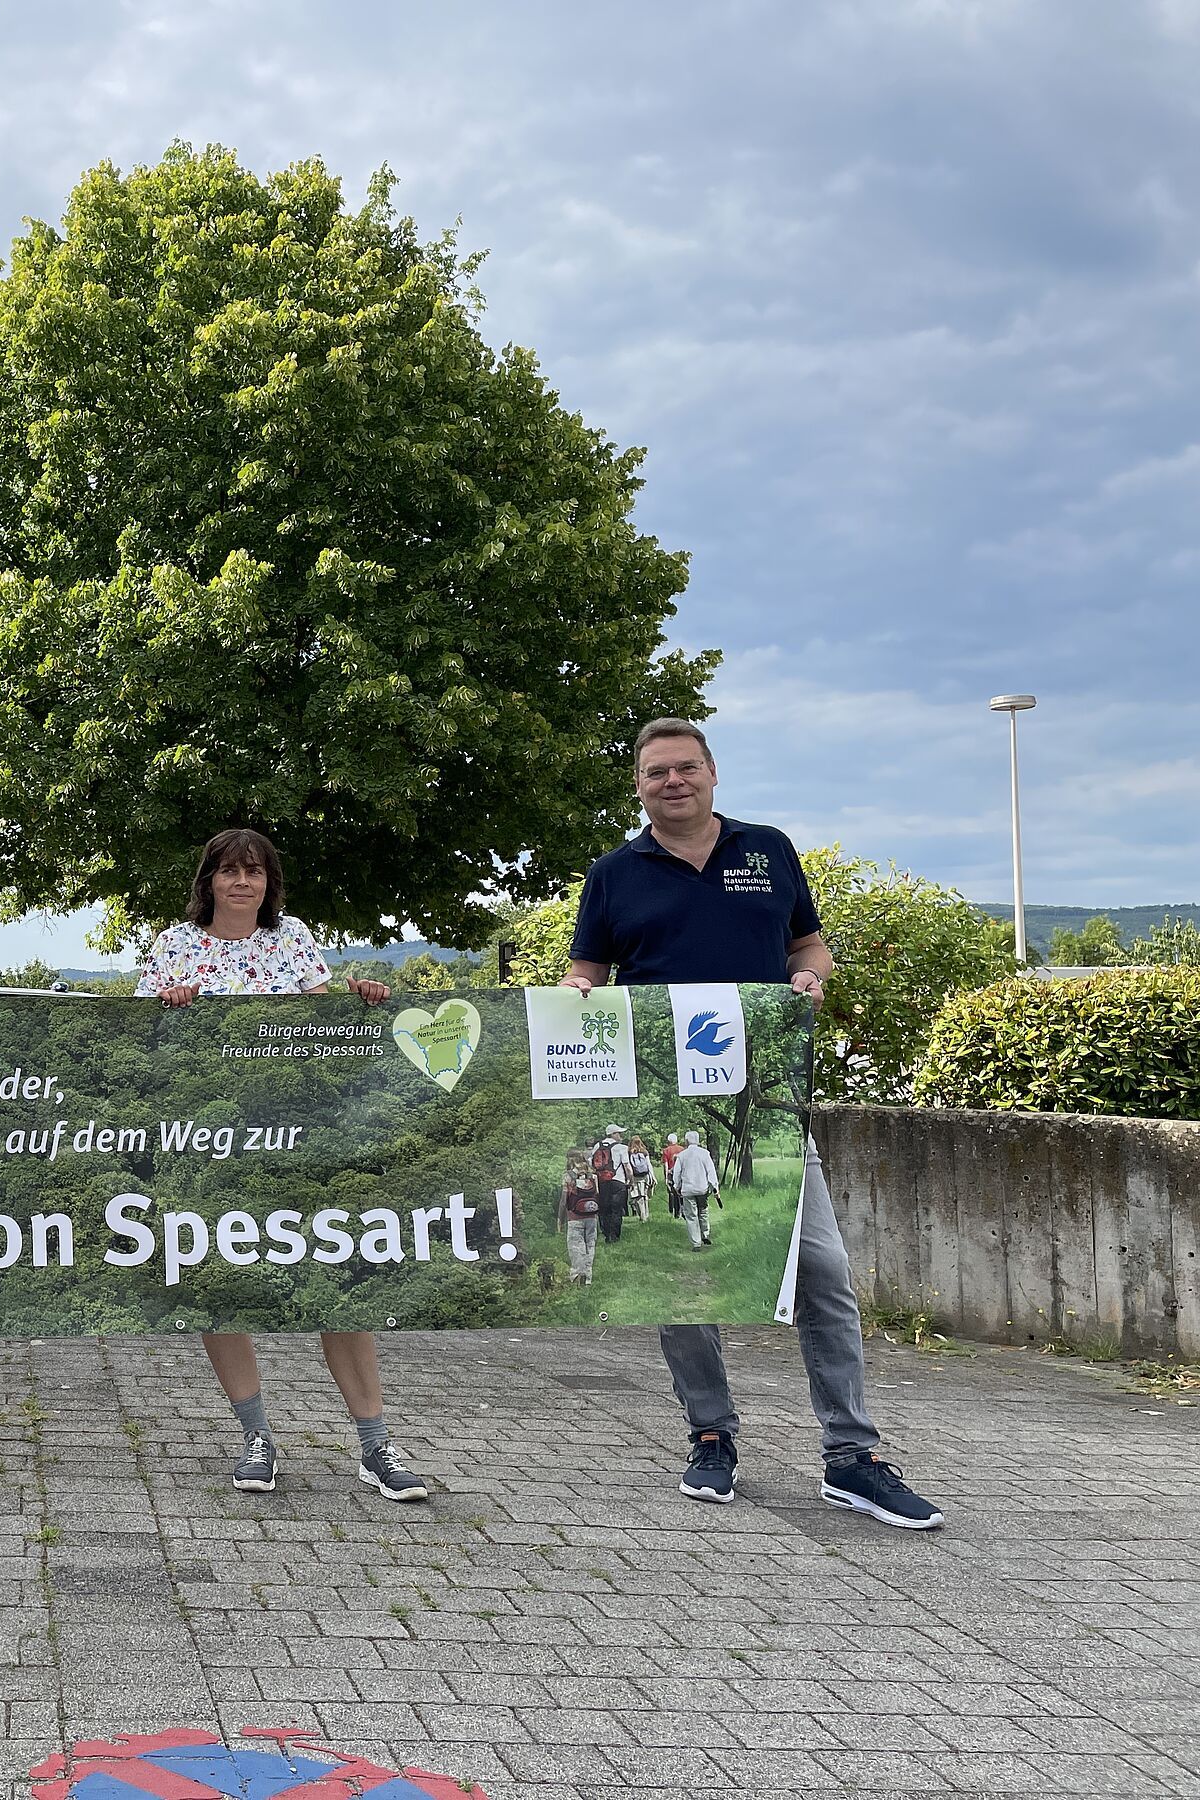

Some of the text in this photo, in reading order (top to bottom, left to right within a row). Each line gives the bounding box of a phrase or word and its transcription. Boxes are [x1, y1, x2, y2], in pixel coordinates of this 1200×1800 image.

[723, 869, 751, 877] BUND
[723, 877, 771, 885] Naturschutz
[734, 884, 761, 893] Bayern
[258, 1022, 383, 1039] Bürgerbewegung
[417, 1029, 437, 1039] Natur
[221, 1043, 384, 1060] Freunde des Spessarts
[546, 1044, 587, 1056] BUND
[547, 1057, 617, 1070] Naturschutz
[548, 1071, 619, 1085] in Bayern e.V.
[689, 1066, 735, 1085] LBV
[5, 1120, 68, 1161] auf
[72, 1120, 147, 1153] dem
[159, 1120, 236, 1160] Weg
[242, 1124, 303, 1152] zur
[103, 1187, 519, 1287] Spessart!
